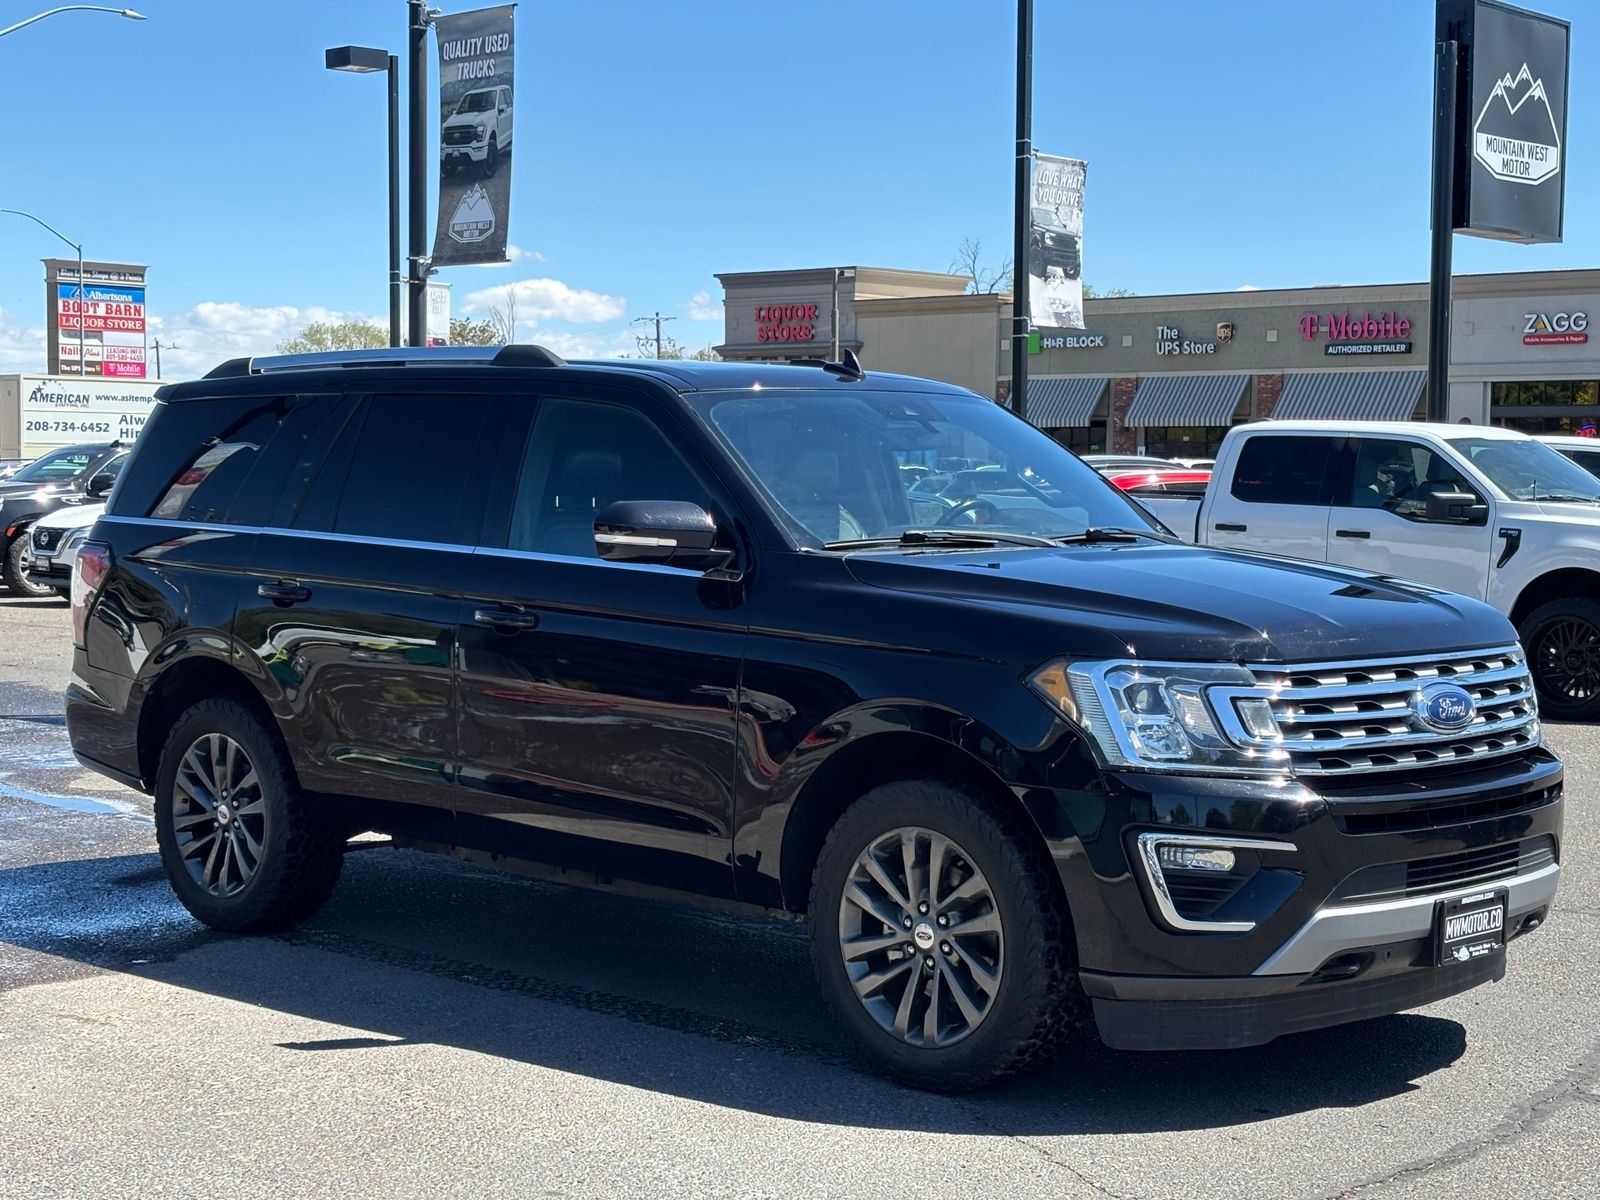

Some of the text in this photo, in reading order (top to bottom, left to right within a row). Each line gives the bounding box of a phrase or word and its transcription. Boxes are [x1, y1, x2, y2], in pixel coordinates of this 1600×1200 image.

[443, 33, 509, 60] QUALITY USED
[457, 59, 495, 80] TRUCKS
[1486, 136, 1549, 162] MOUNTAIN WEST
[1502, 157, 1531, 176] MOTOR
[1038, 170, 1083, 189] LOVE WHAT
[1038, 187, 1080, 207] YOU DRIVE
[89, 291, 132, 302] Albertsons
[62, 300, 142, 317] BOOT BARN
[754, 304, 817, 325] LIQUOR
[62, 317, 143, 330] LIQUOR STORE
[1523, 312, 1587, 333] ZAGG
[758, 323, 813, 340] STORE
[1157, 326, 1178, 339] The
[1217, 328, 1231, 340] ups
[1043, 336, 1104, 348] H&R BLOCK
[1156, 341, 1215, 355] UPS Store
[1328, 344, 1406, 354] AUTHORIZED RETAILER
[61, 346, 81, 356] Nail
[28, 390, 157, 405] AMERICAN www.asitemp.
[26, 415, 146, 433] 208-734-6452 Alw
[119, 428, 140, 439] Hir
[1439, 697, 1466, 719] Ford
[1446, 908, 1501, 939] MWMOTOR.CO
